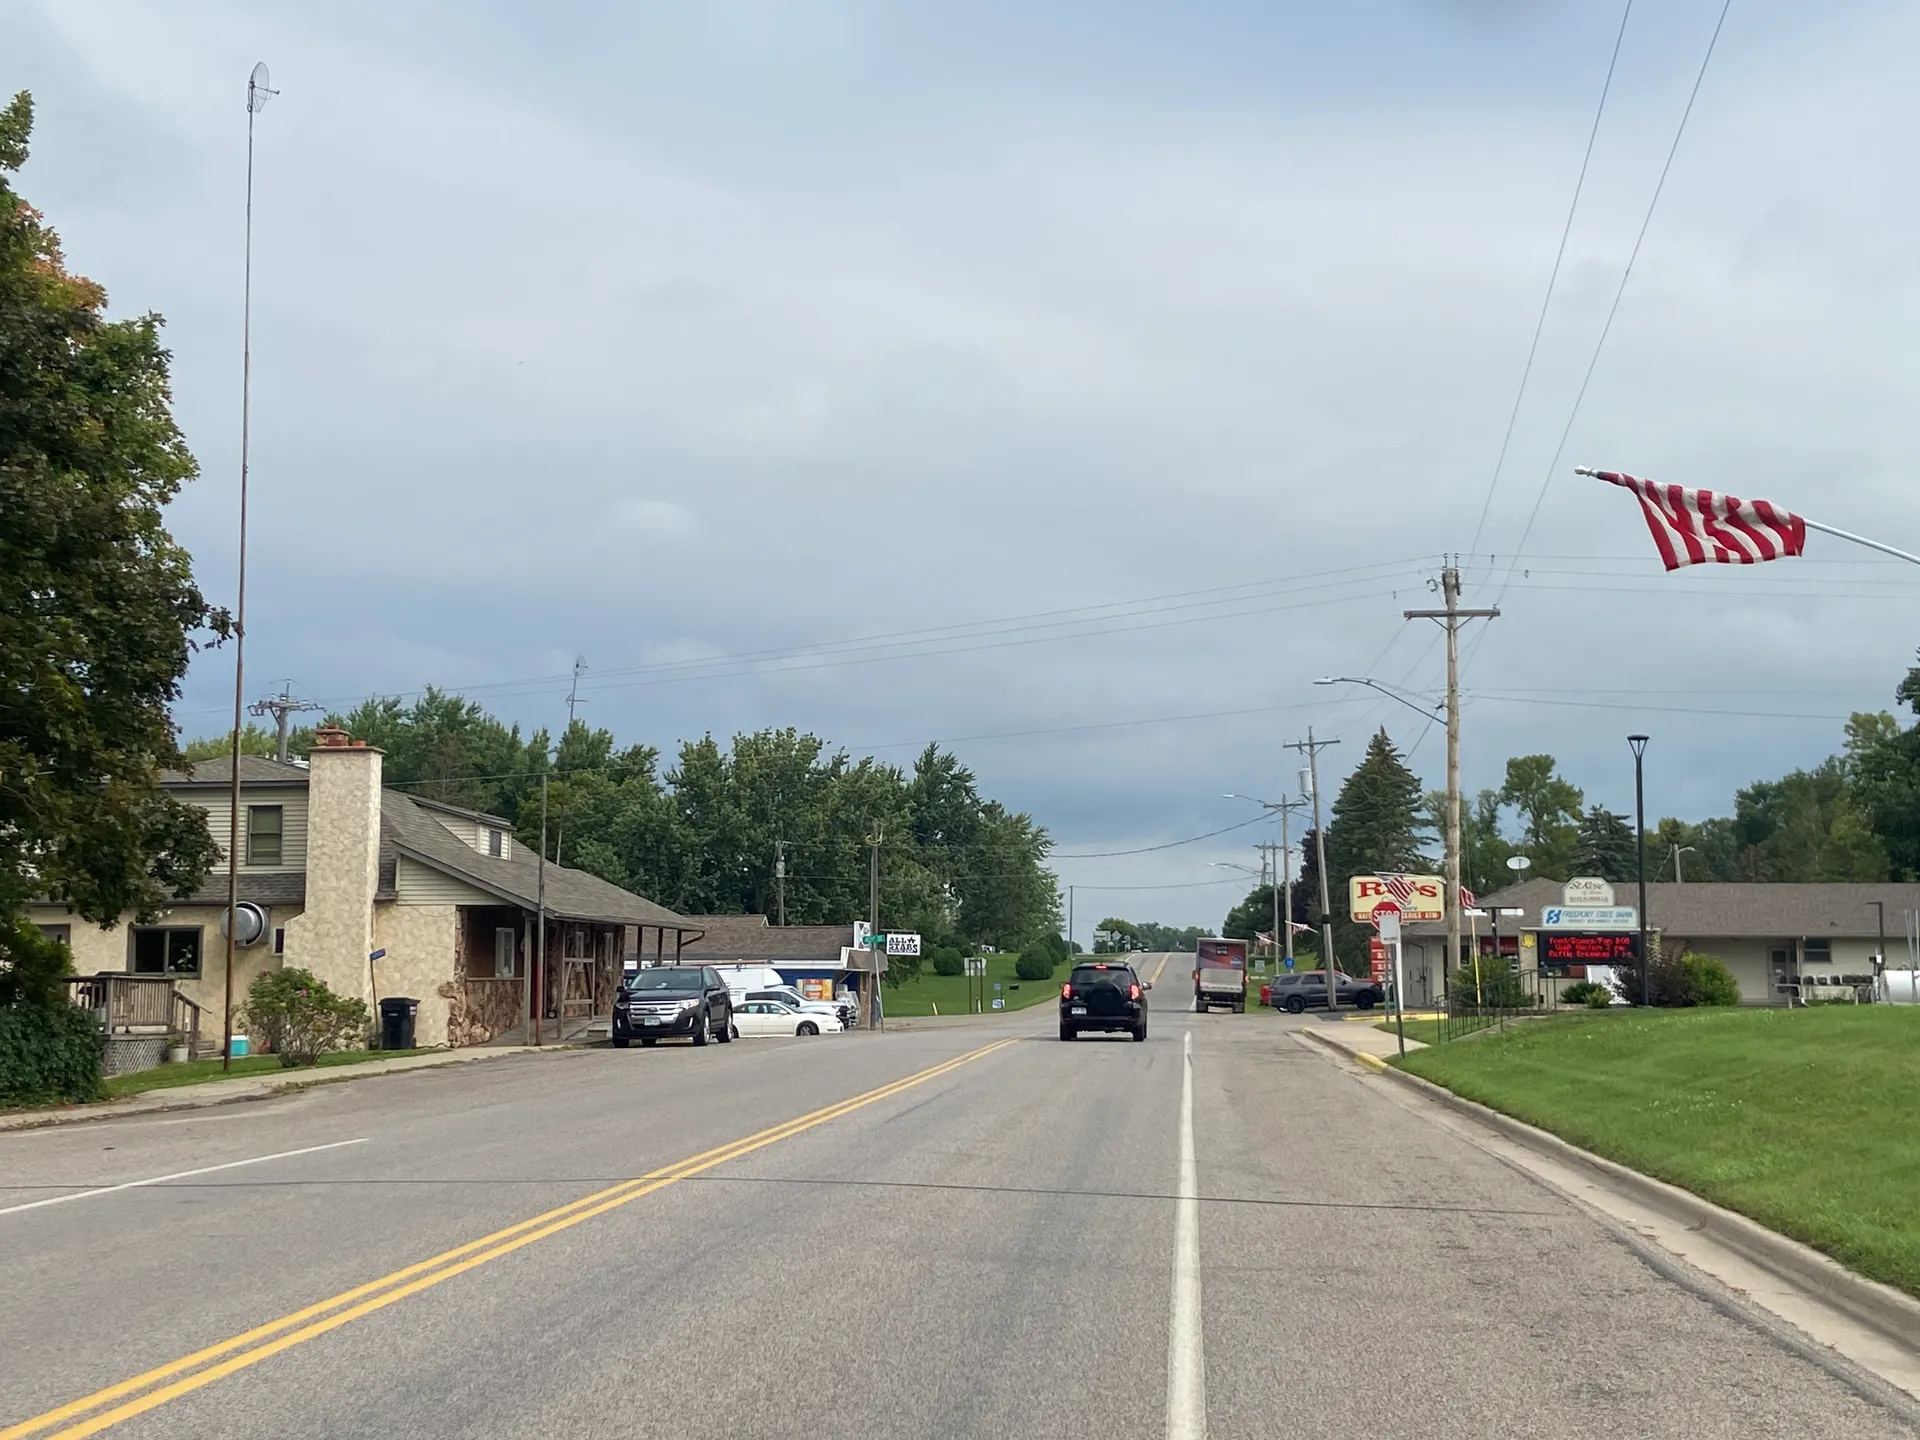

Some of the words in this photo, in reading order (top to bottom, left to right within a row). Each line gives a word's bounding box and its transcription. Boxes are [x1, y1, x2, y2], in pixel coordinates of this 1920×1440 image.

[1562, 910, 1594, 918] FREEPORT
[1596, 910, 1613, 918] STATE
[889, 944, 918, 953] STARS
